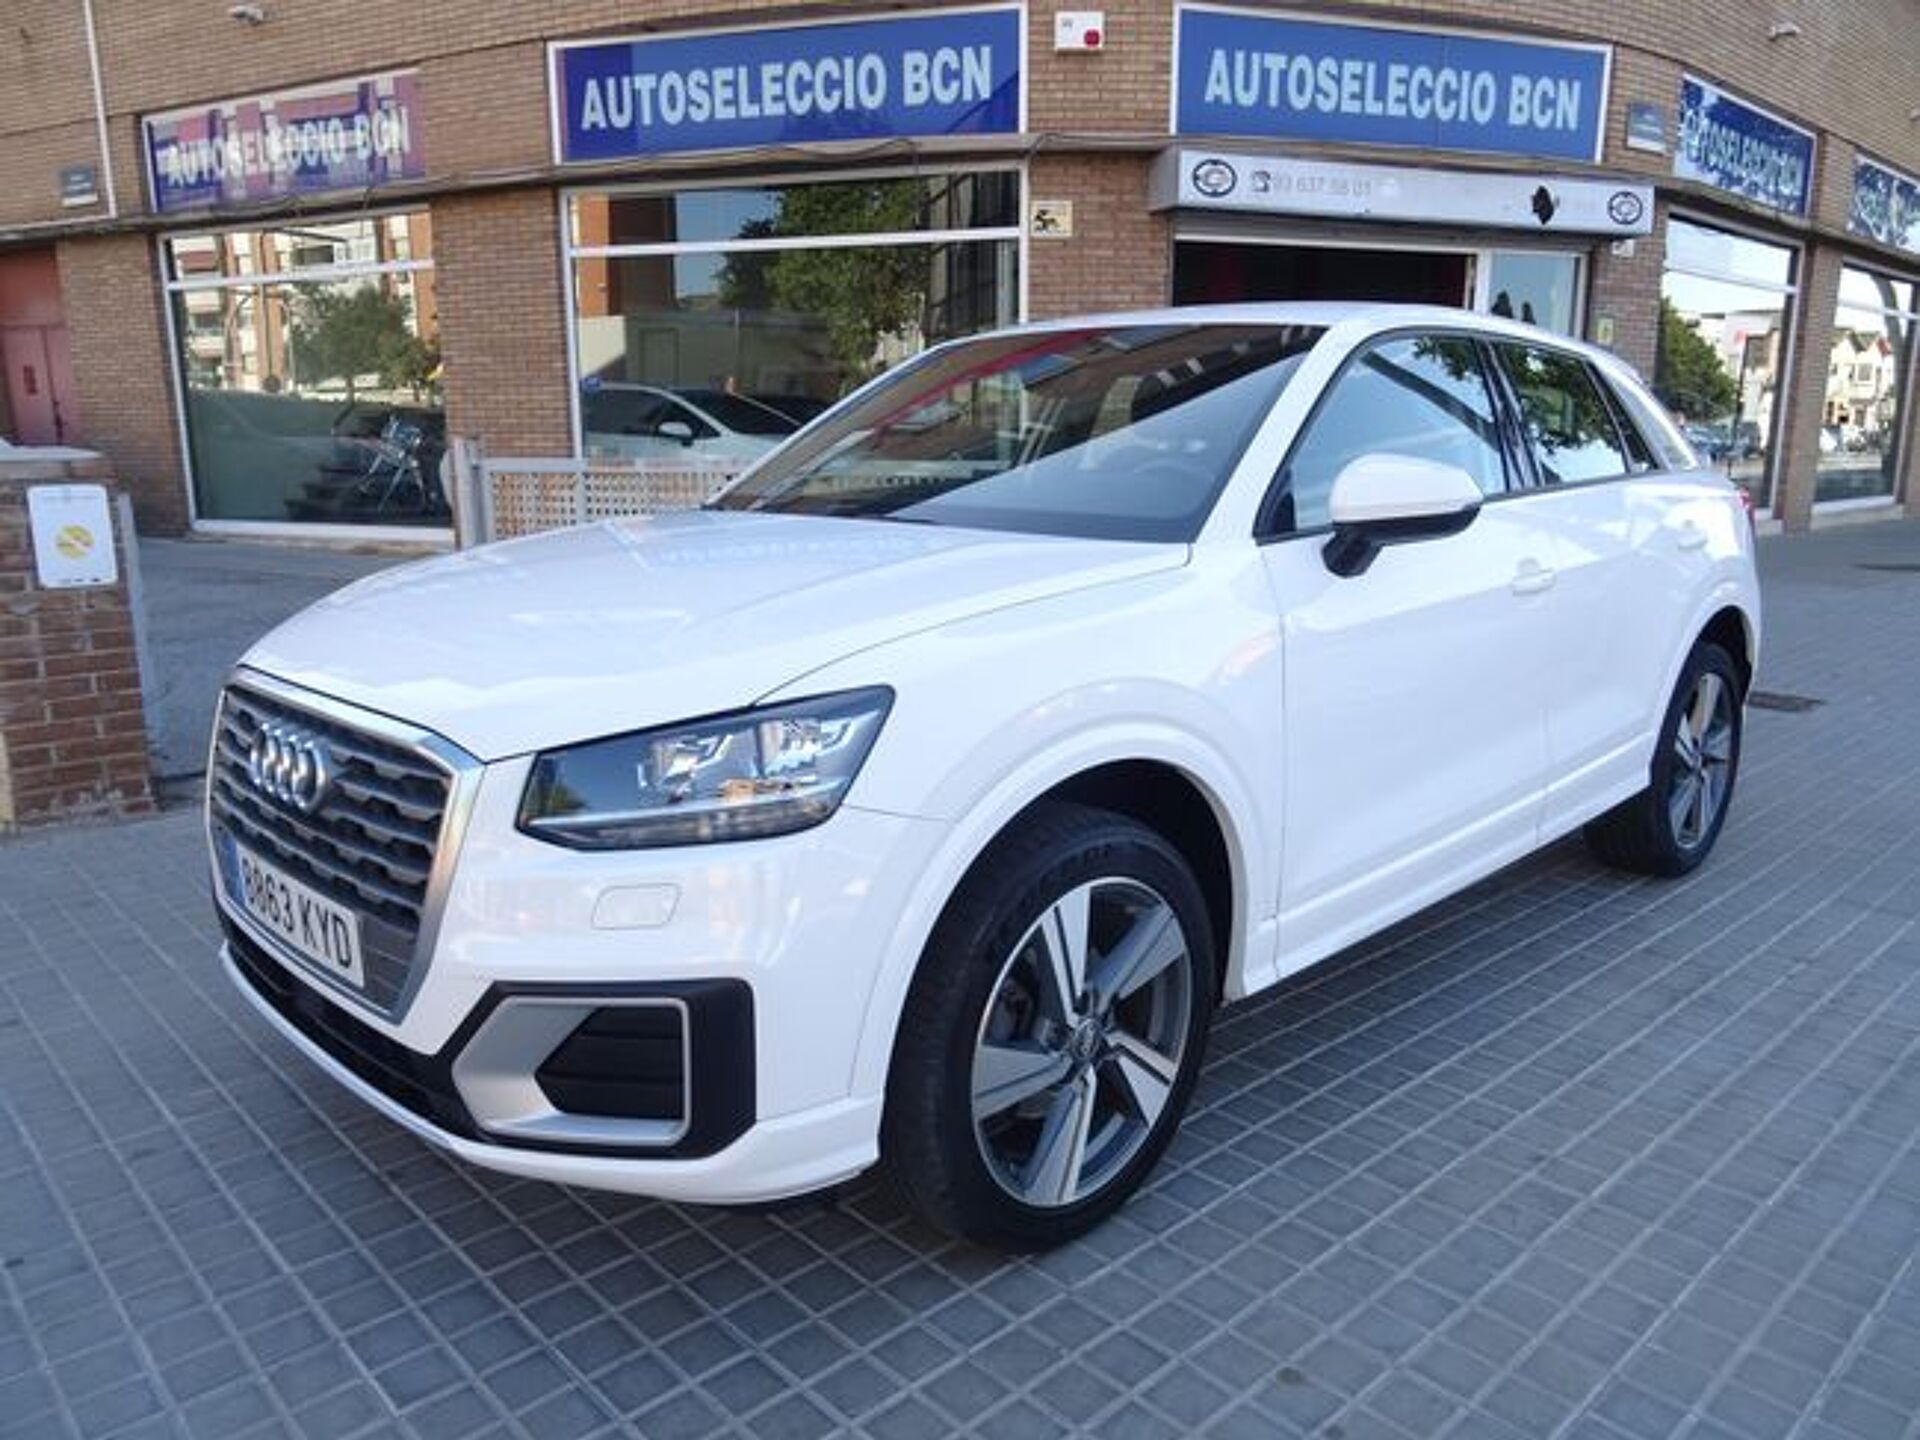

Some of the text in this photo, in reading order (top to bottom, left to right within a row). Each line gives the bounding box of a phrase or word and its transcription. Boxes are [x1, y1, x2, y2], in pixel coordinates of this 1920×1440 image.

[581, 45, 991, 131] AUTOSELECCIO BCN
[1204, 48, 1582, 131] AUTOSELECCIO BCN
[298, 894, 352, 969] KYD
